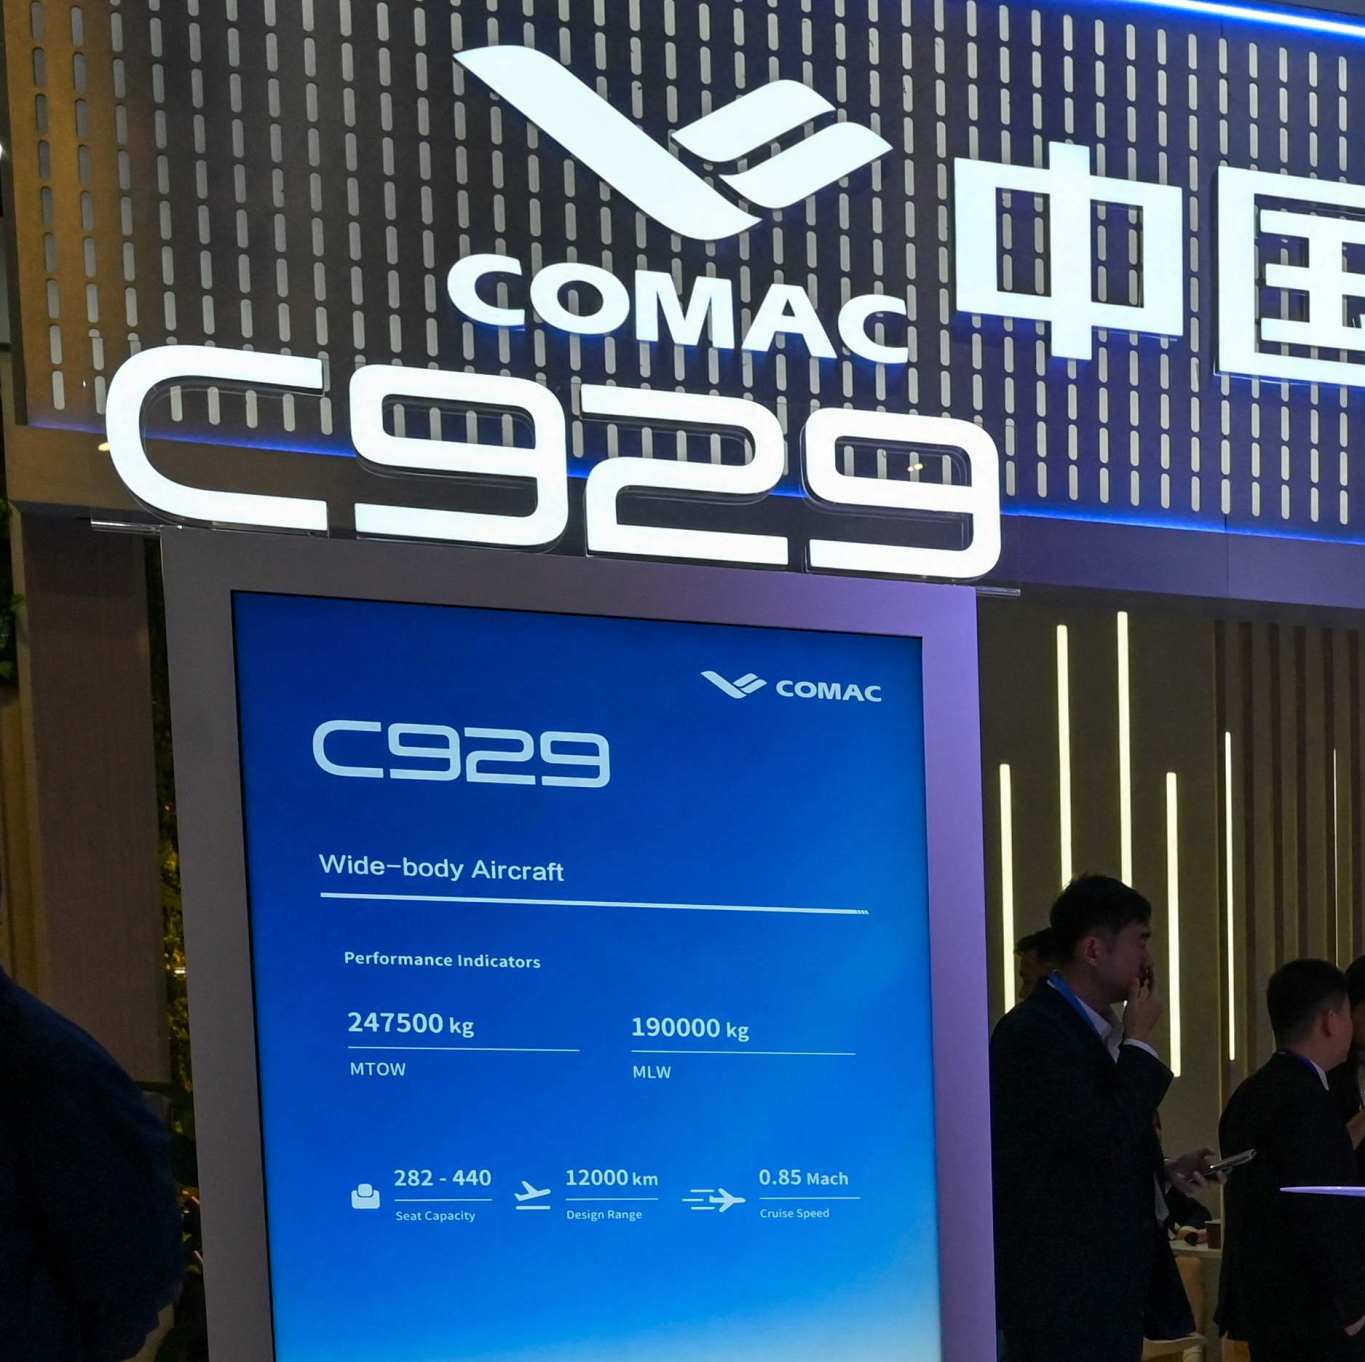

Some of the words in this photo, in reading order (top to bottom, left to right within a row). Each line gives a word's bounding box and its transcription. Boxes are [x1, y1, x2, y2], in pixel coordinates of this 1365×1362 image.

[447, 254, 908, 364] COMAC
[105, 345, 1001, 581] C929
[776, 680, 881, 702] COMAC
[313, 720, 610, 787] C929
[319, 854, 464, 881] Wide-body
[472, 860, 564, 881] Aircraft
[345, 952, 452, 966] Performance
[458, 955, 540, 968] Indicators
[348, 1012, 443, 1033] 247500
[450, 1017, 474, 1038] kg
[633, 1017, 720, 1037] 190000
[727, 1022, 749, 1042] kg
[351, 1062, 405, 1076] MTOW
[633, 1066, 671, 1078] MLW
[395, 1170, 433, 1186] 282
[453, 1170, 491, 1185] 440
[567, 1169, 628, 1185] 12000
[633, 1172, 657, 1185] km
[760, 1169, 801, 1185] 0.85
[807, 1172, 848, 1185] Mach
[396, 1211, 422, 1221] Seat
[425, 1211, 475, 1222] Capacity
[567, 1210, 604, 1222] Design
[608, 1210, 642, 1222] Range
[760, 1209, 794, 1218] Cruise
[797, 1209, 829, 1219] Speed
